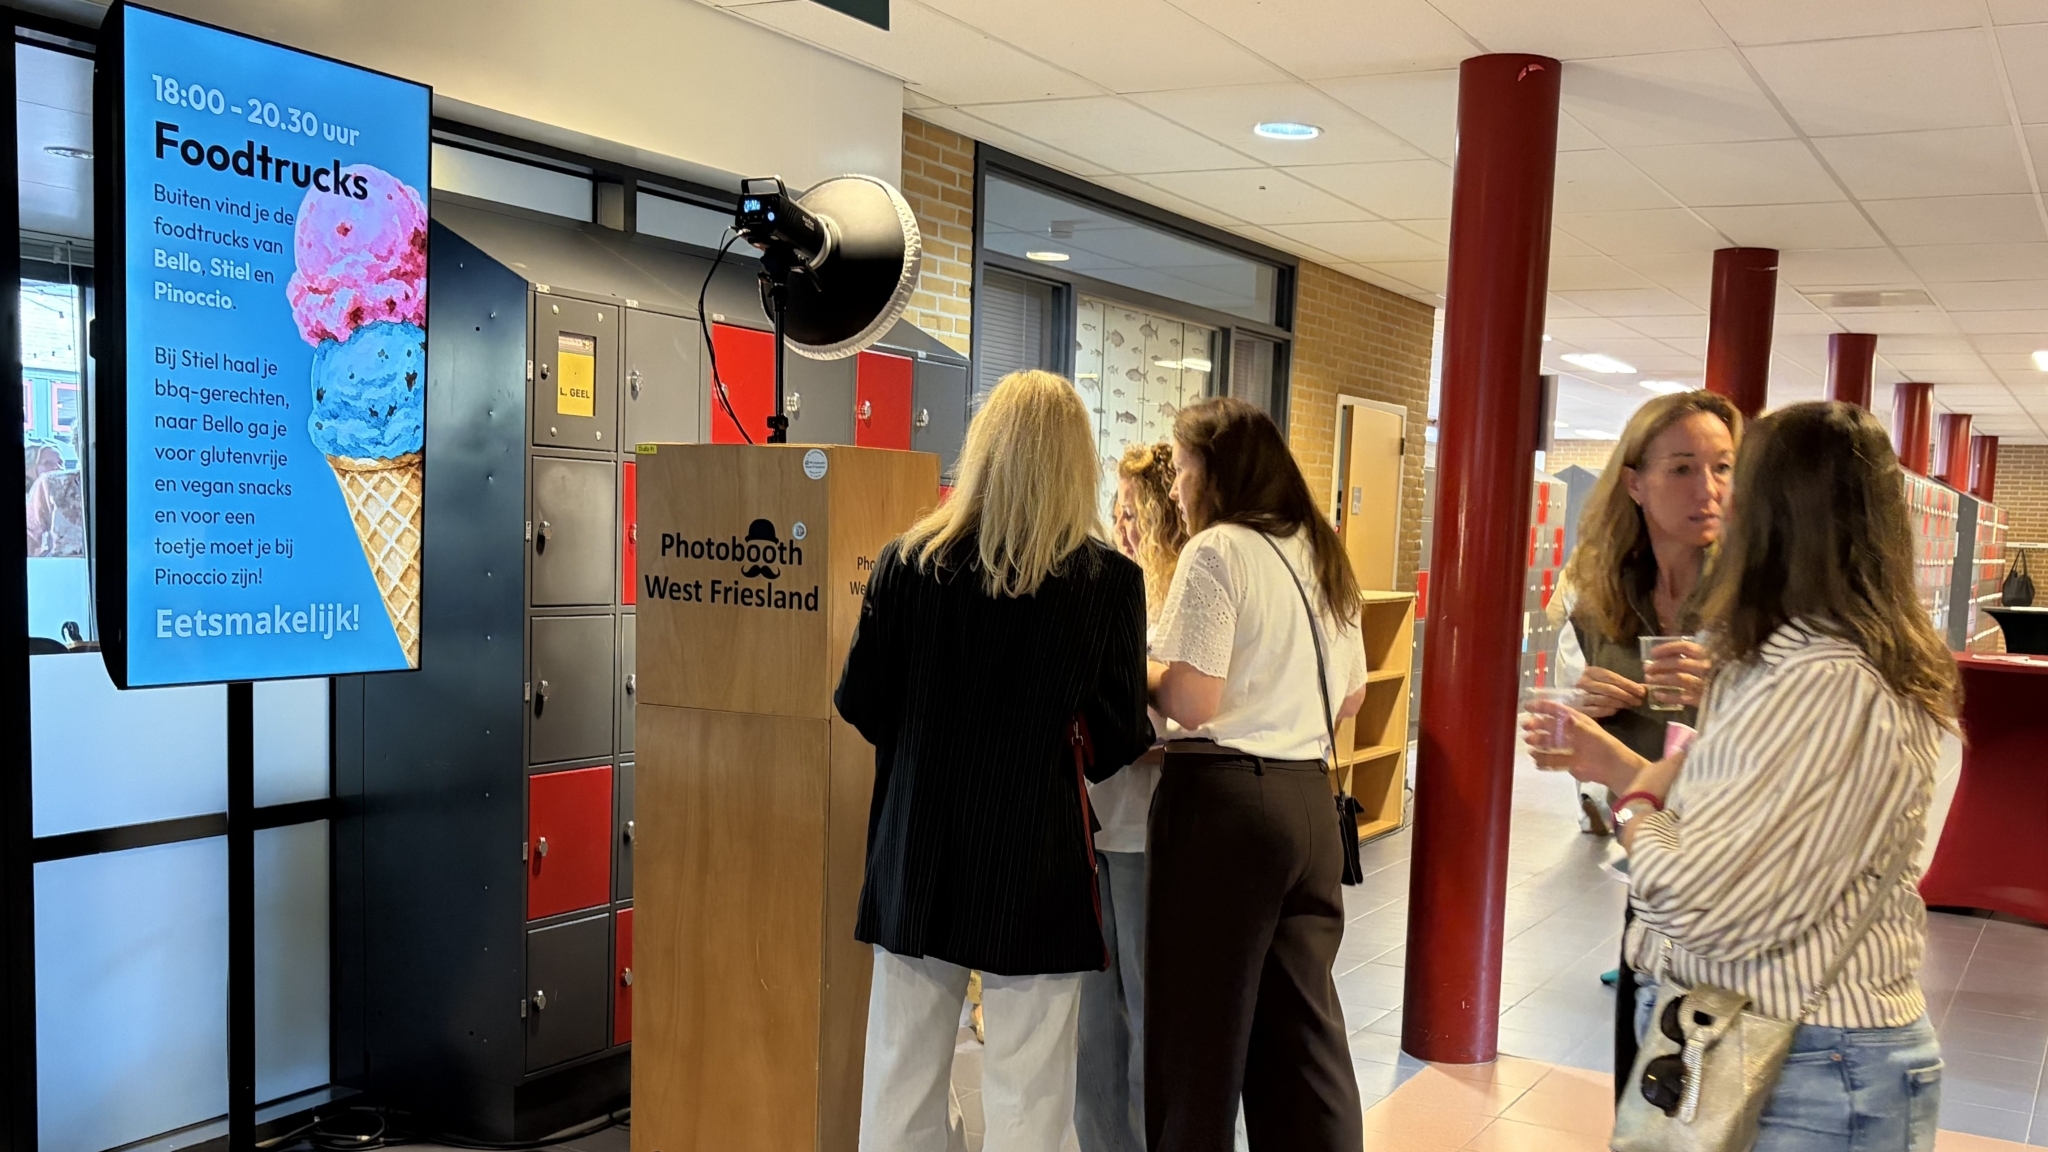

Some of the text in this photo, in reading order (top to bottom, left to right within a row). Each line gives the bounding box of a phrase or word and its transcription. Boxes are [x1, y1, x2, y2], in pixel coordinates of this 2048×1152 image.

[152, 74, 224, 114] 18:00
[248, 98, 318, 136] 20.30
[323, 123, 359, 146] uur
[156, 120, 368, 200] Foodtrucks
[155, 184, 294, 225] Buiten vind je de
[153, 216, 283, 254] foodtrucks van
[154, 248, 274, 283] Bello, Stiel en
[155, 281, 236, 309] Pinoccio.
[155, 347, 277, 376] Bij Stiel haal je
[155, 379, 289, 410] bbq-gerechten,
[570, 388, 590, 399] GEEL
[155, 415, 287, 439] naar Bello ga je
[155, 446, 287, 470] voor glutenvrije
[155, 479, 291, 497] en vegan snacks
[155, 510, 255, 524] en voor een
[155, 537, 293, 558] toetje moet je bij
[662, 533, 802, 565] Photobooth
[155, 568, 262, 588] Pinoccio zijn!
[645, 574, 819, 611] West Friesland
[156, 604, 360, 639] Eetsmakelijk!
